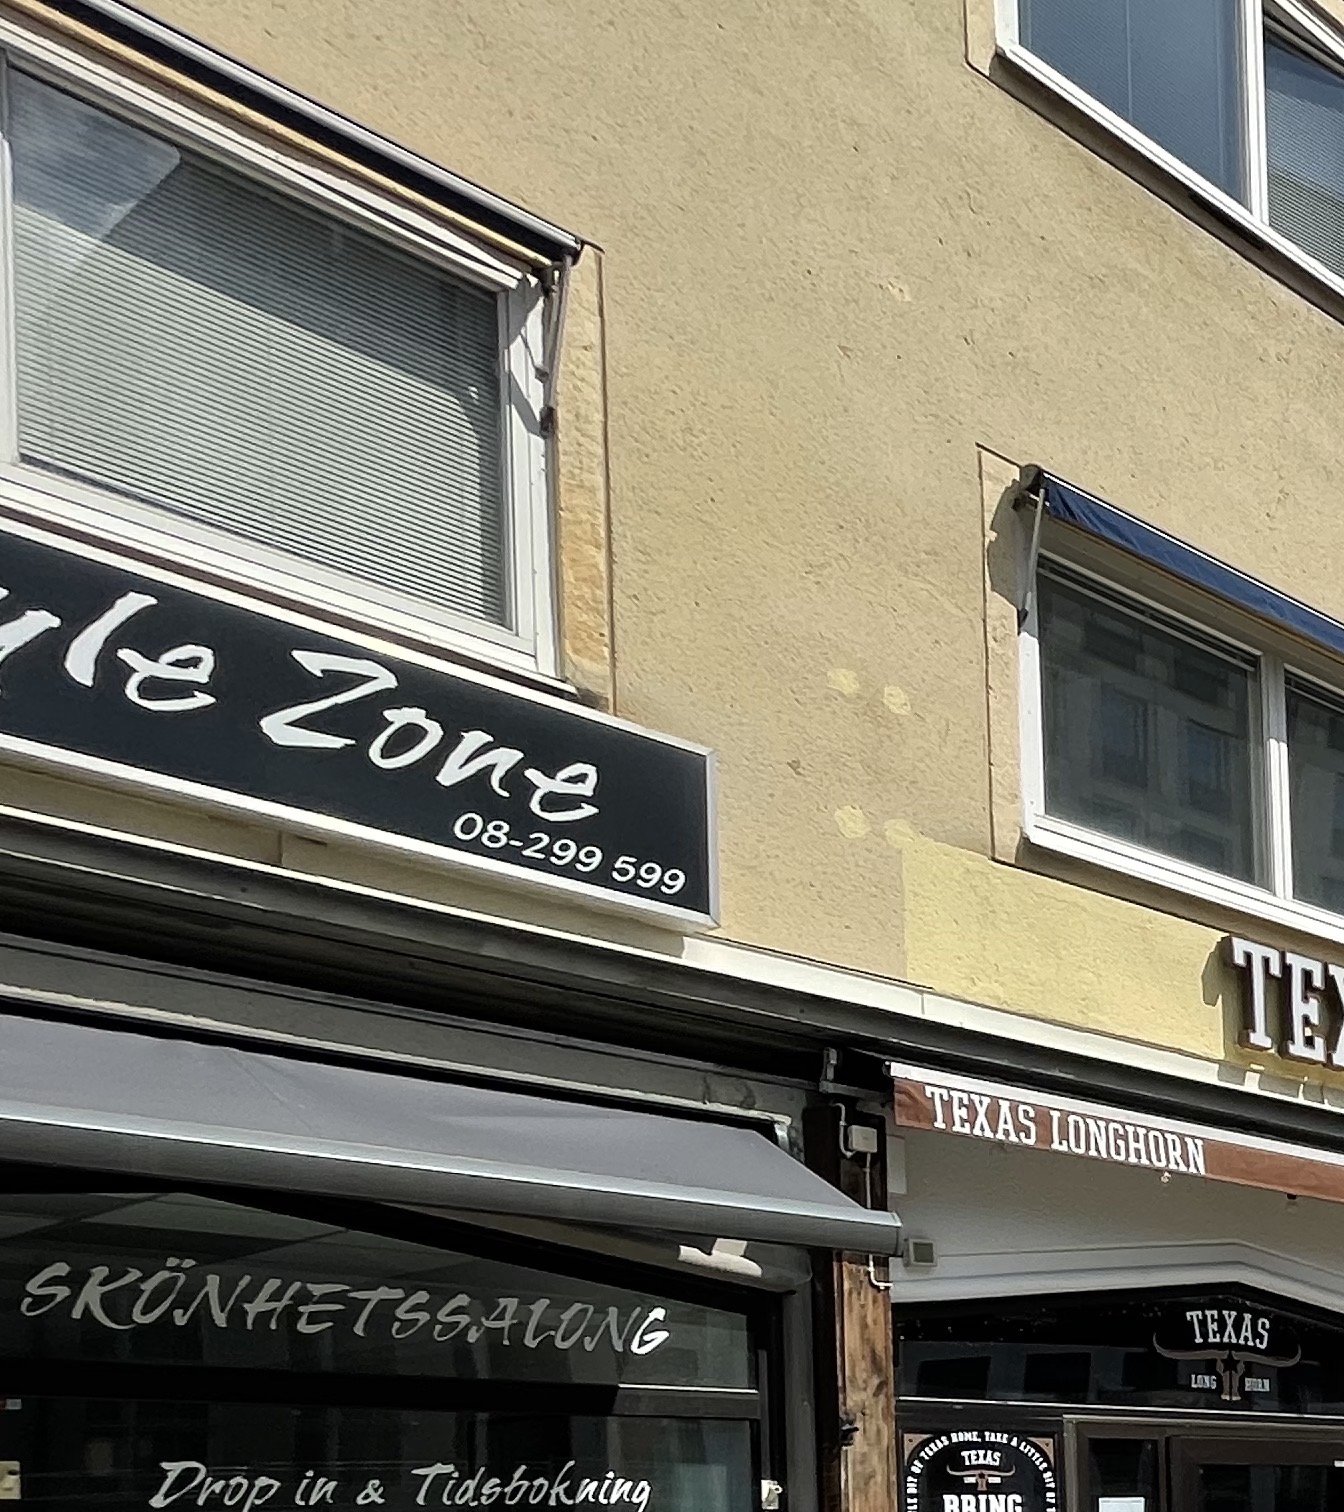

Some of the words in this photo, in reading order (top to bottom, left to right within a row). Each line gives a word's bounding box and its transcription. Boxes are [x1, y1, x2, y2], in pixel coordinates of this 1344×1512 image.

[259, 648, 600, 822] Zone
[453, 812, 602, 875] 08-299
[611, 855, 687, 896] 599
[924, 1085, 1037, 1146] TEXAS
[1050, 1110, 1206, 1176] LONGHORN
[20, 1257, 670, 1356] SKÖNHETSSALONG
[1186, 1309, 1270, 1349] TEXAS
[1191, 1374, 1217, 1390] LONG
[295, 1469, 335, 1507] in
[356, 1481, 386, 1506] &
[961, 1450, 1001, 1466] TEXAS
